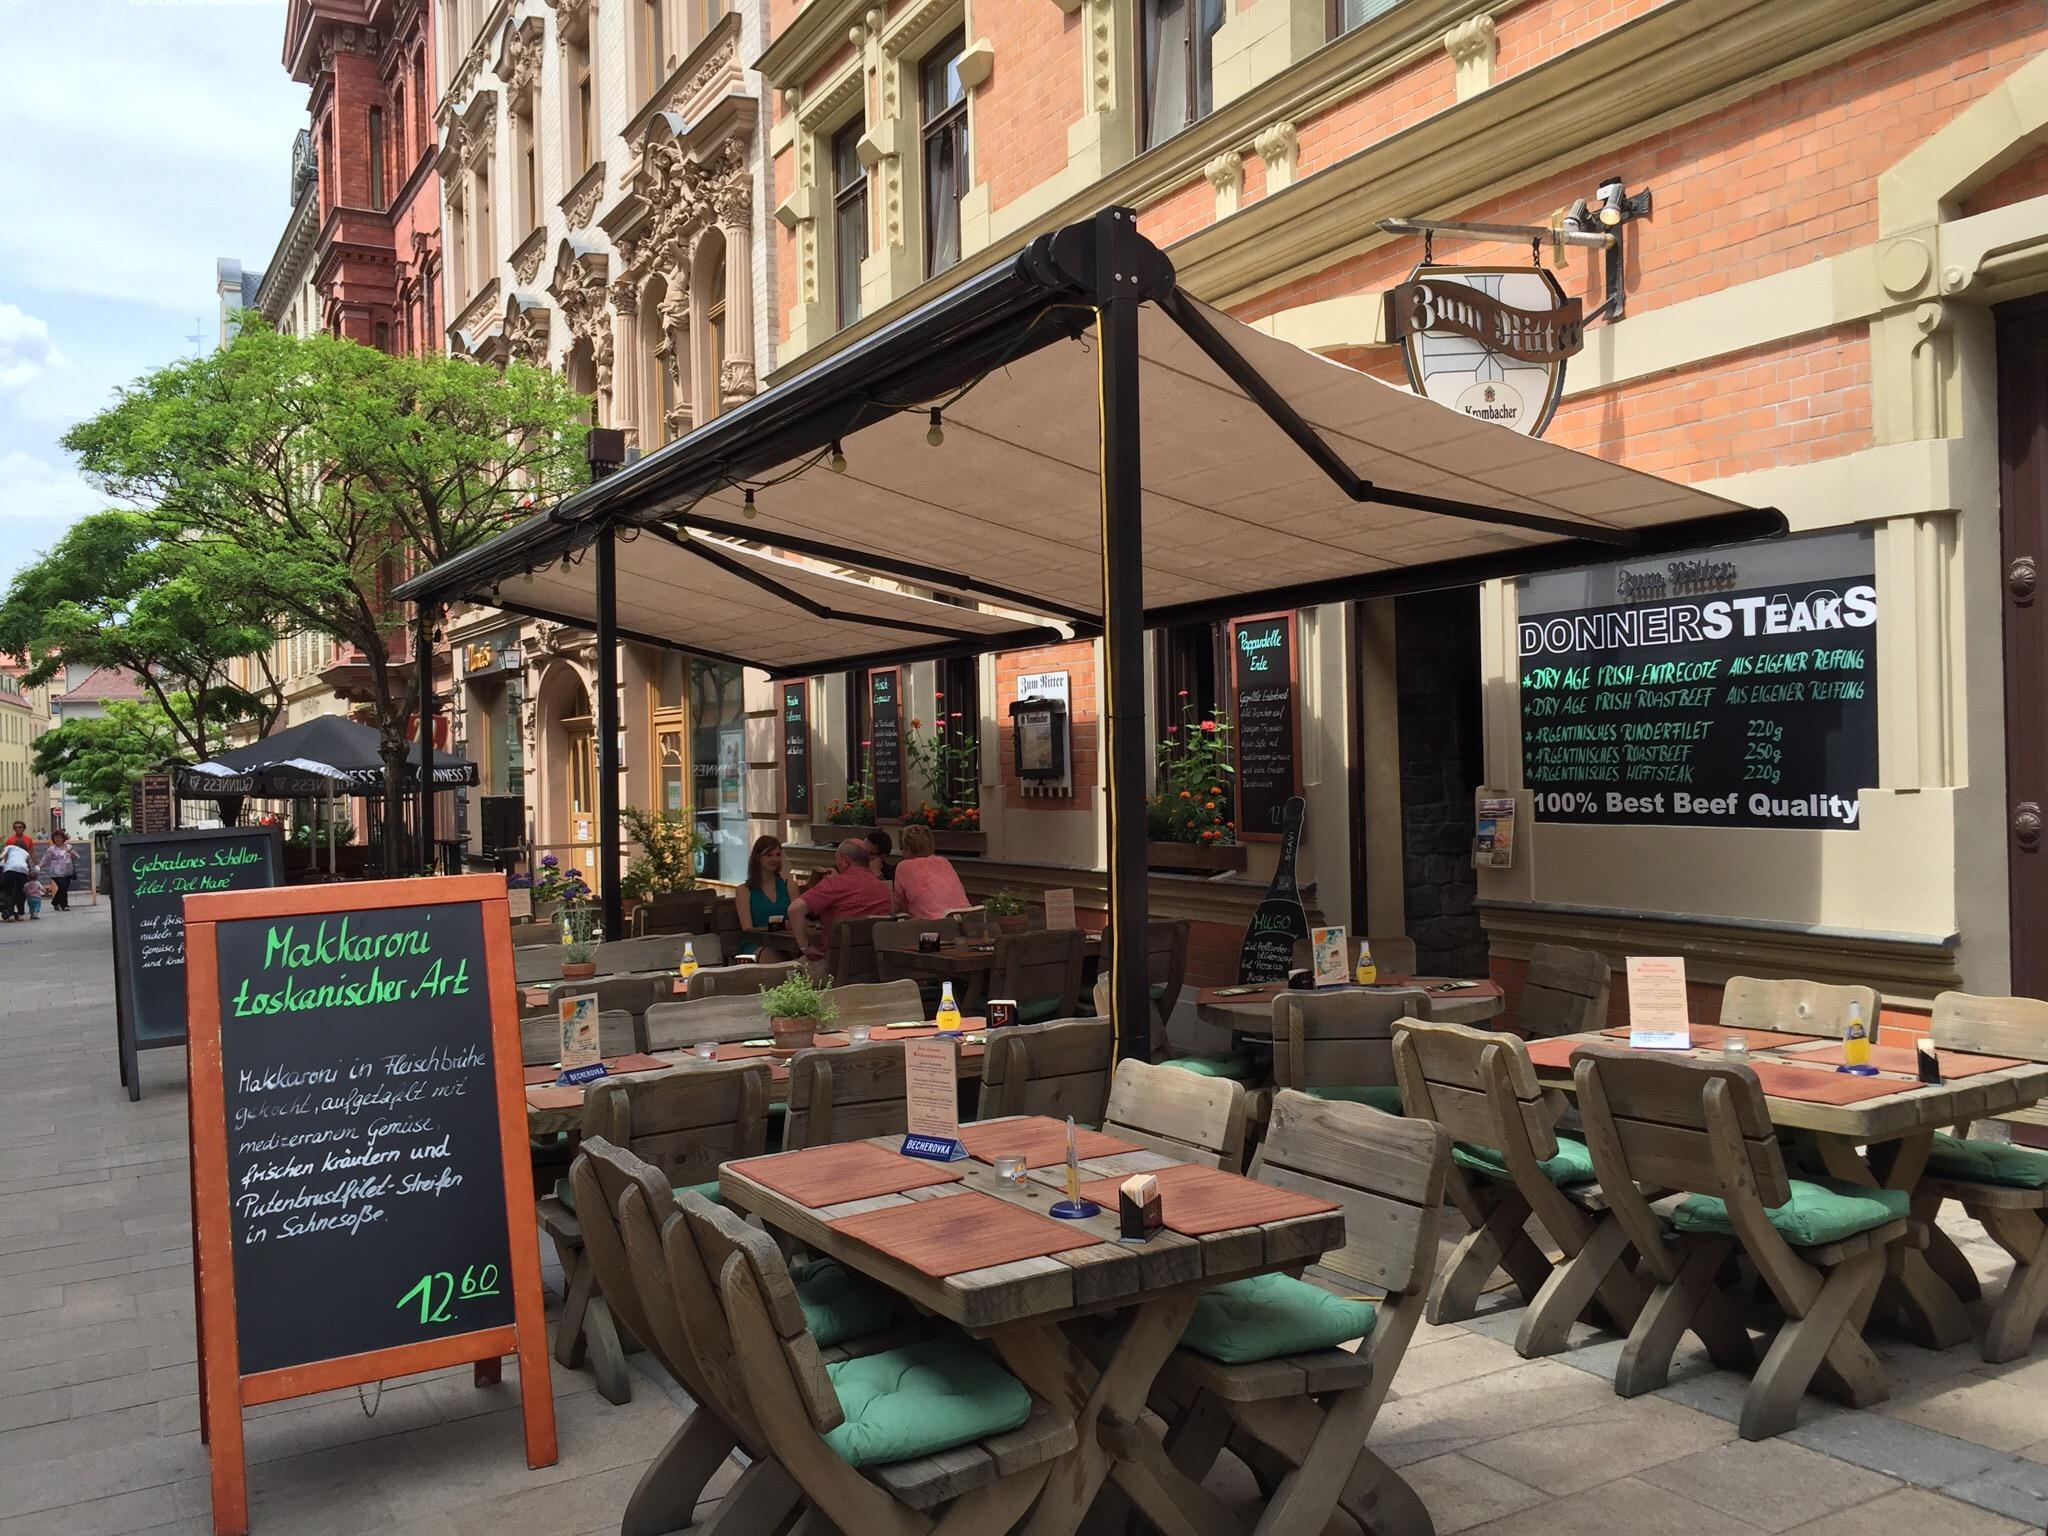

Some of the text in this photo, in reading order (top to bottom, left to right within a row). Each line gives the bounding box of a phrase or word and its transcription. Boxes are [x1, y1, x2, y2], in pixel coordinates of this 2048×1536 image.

[1410, 284, 1582, 354] Zum Ritter
[1465, 405, 1517, 419] Krombacher
[1617, 559, 1738, 597] Zum Ritter
[1021, 675, 1064, 694] Zum Ritter
[1561, 666, 1591, 690] AGE
[1727, 655, 1753, 677] AUS
[1753, 651, 1808, 675] EIGENER
[1561, 696, 1588, 715] AGE
[1595, 691, 1631, 713] IRISH
[1635, 687, 1716, 709] ROASTBEEF
[1725, 684, 1750, 705] AUS
[1751, 681, 1805, 703] EIGENER
[1533, 720, 1784, 743] ARGENTINISCHES RINDERFILET 220g
[1535, 743, 1783, 765] ARGENTINISCHES ROASTBEEF 250g
[1533, 766, 1620, 783] ARGENTINISCHES
[1743, 765, 1782, 785] 220g
[1535, 793, 1598, 814] 100%
[1607, 792, 1665, 814] Best
[1674, 792, 1739, 815] Beef
[1749, 793, 1859, 824] Quality
[132, 852, 206, 880] Gebratenes
[263, 913, 431, 970] Makkaroni
[142, 957, 161, 968] und
[232, 957, 470, 1017] toskanischer Art
[238, 1044, 486, 1094] Makkaroni in Fleischbrühe
[431, 1076, 468, 1098] mit
[906, 1139, 951, 1155] BECHEROVKA
[240, 1155, 314, 1190] frischen
[409, 1133, 451, 1159] und
[245, 1224, 267, 1245] in
